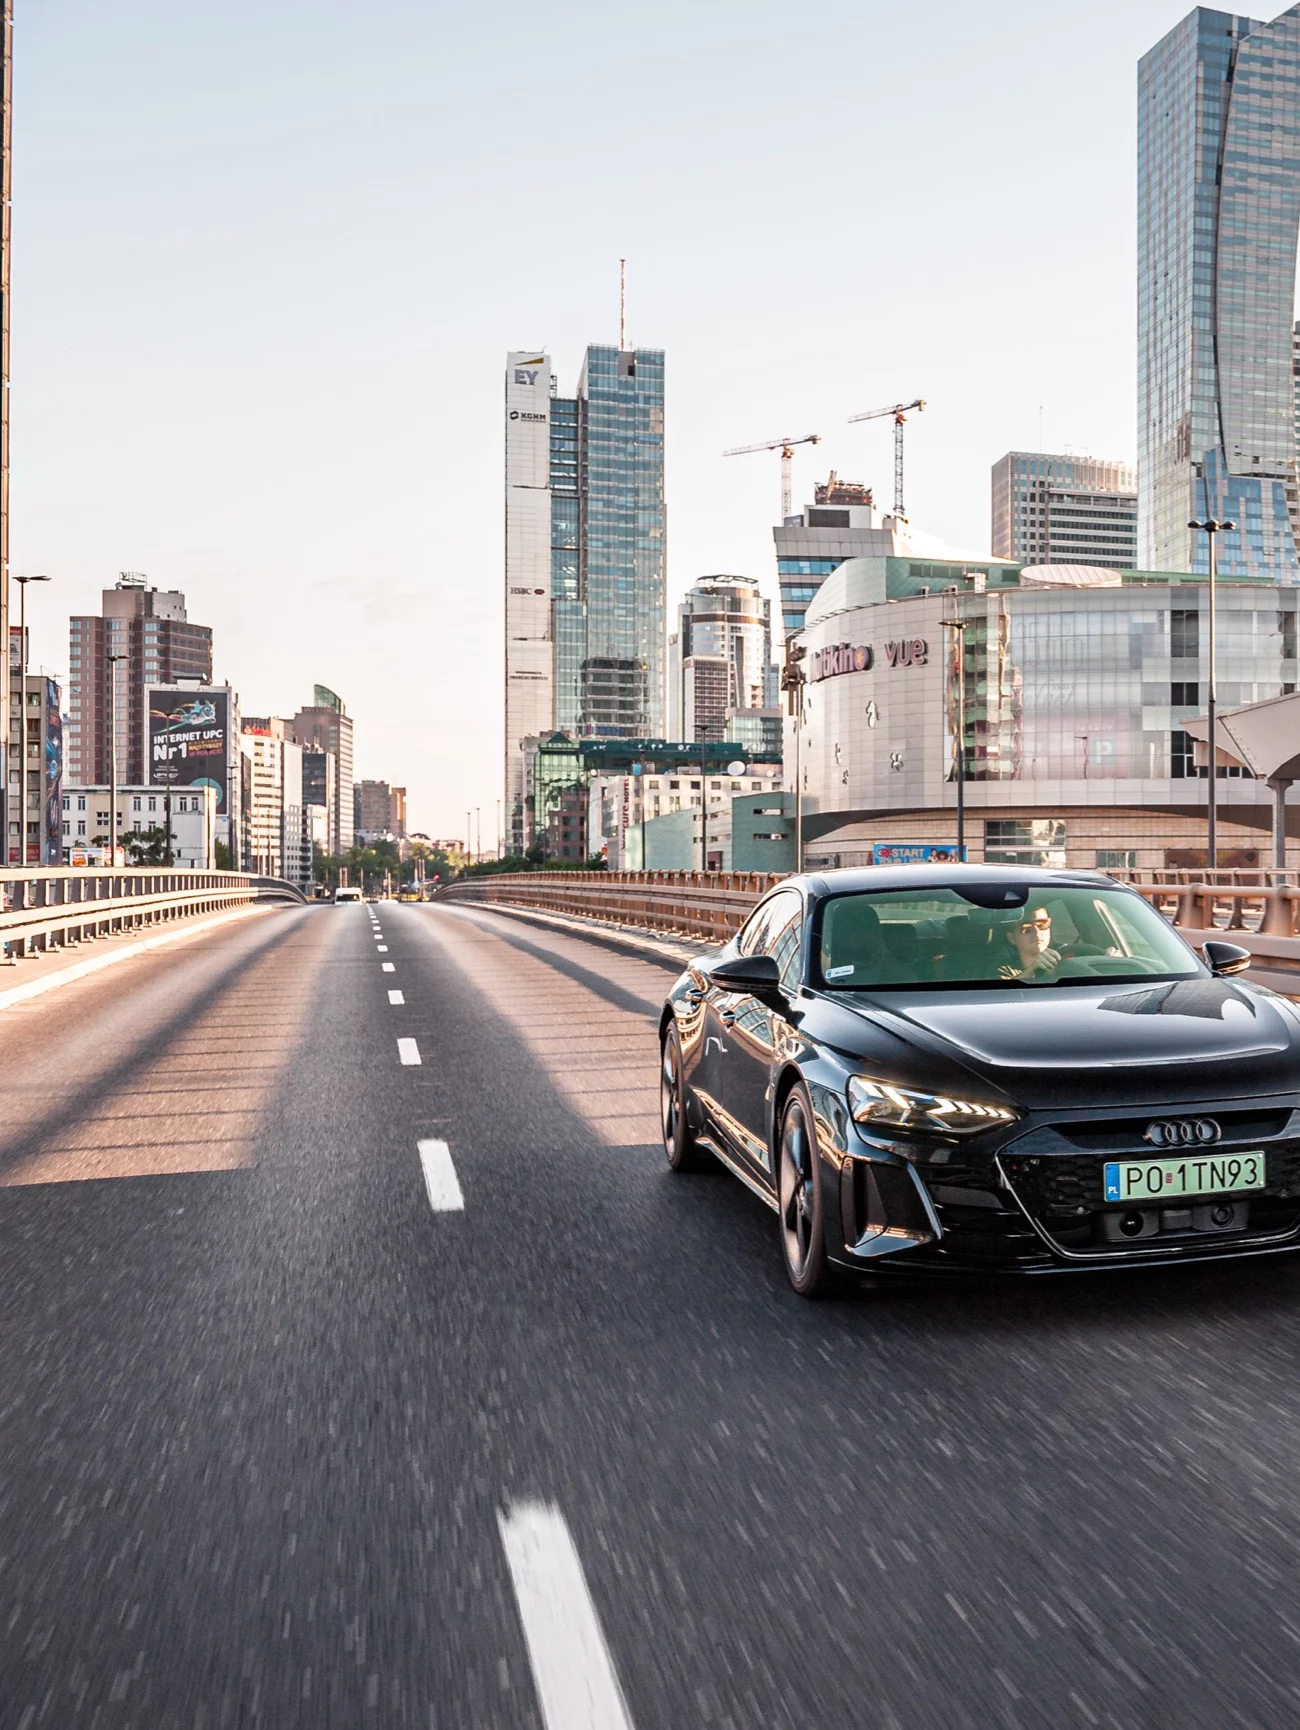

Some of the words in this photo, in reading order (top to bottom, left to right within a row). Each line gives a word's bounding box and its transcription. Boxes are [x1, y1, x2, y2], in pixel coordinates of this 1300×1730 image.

[515, 369, 539, 385] EY
[521, 412, 546, 420] KGHM
[884, 639, 928, 667] vue
[153, 731, 201, 744] INTERNET
[203, 729, 223, 740] UPC
[1127, 1166, 1163, 1195] PO
[1177, 1158, 1257, 1191] 1TN93
